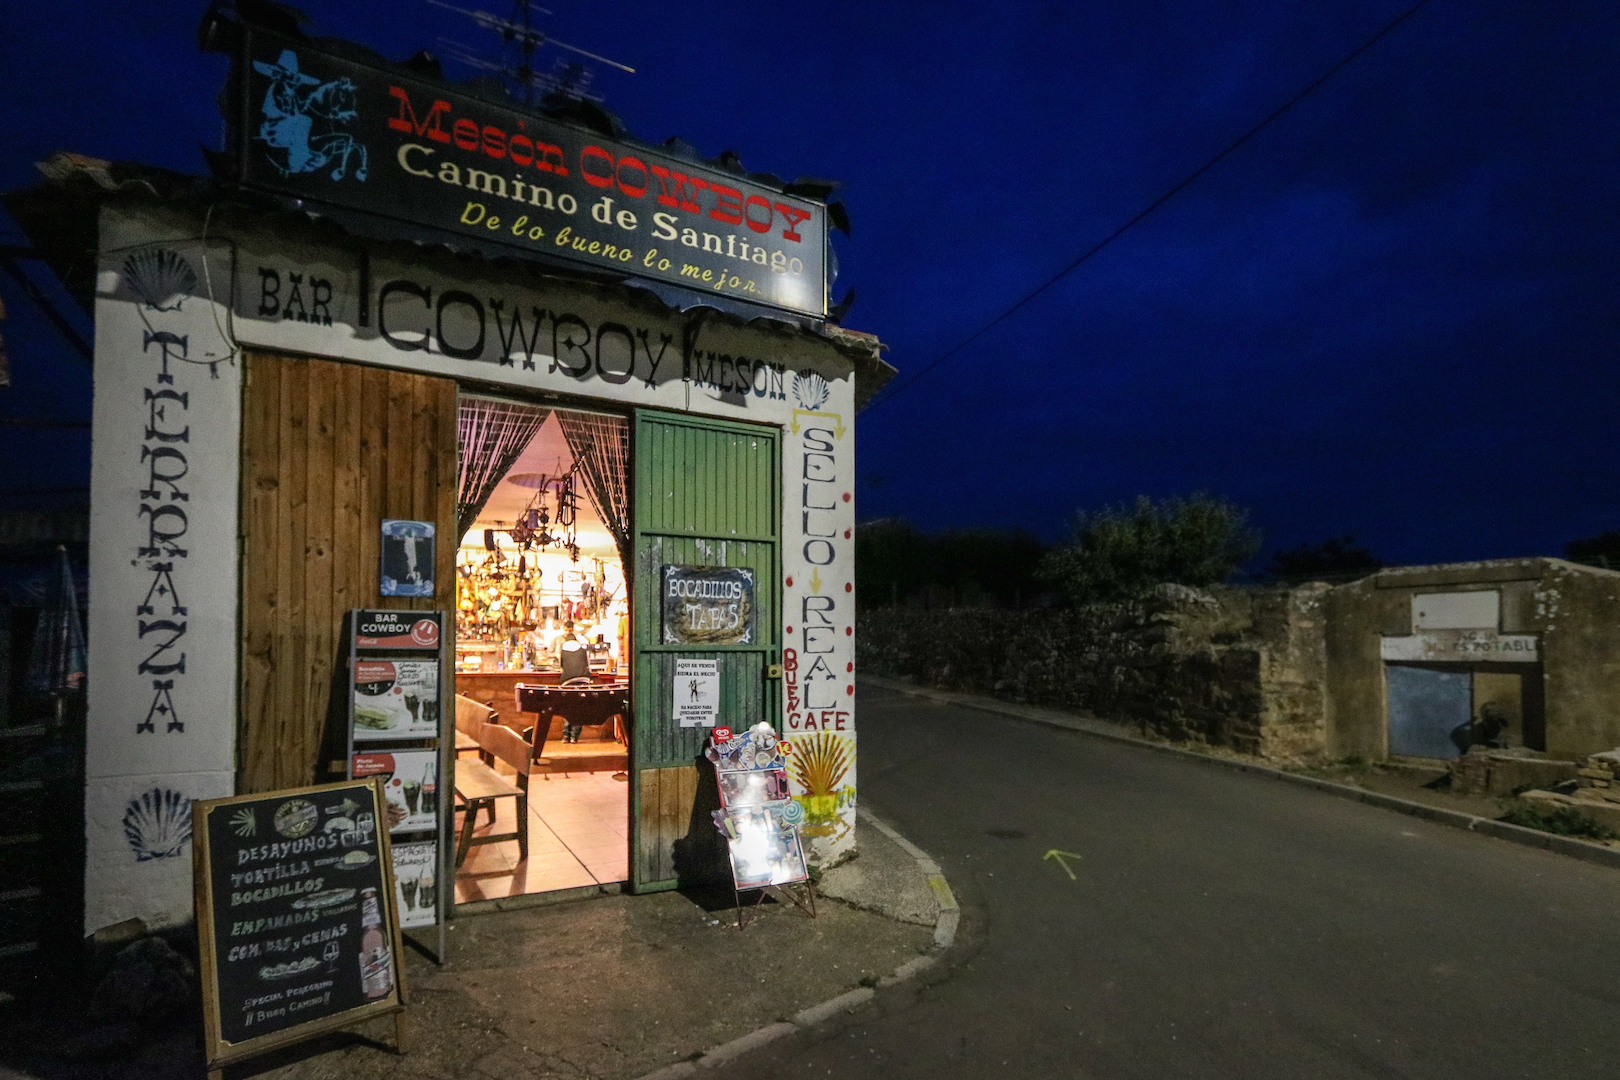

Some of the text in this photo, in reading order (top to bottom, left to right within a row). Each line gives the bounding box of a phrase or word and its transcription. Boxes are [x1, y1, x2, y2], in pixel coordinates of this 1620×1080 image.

[397, 143, 804, 274] Camino de Santiago
[580, 145, 811, 243] COWBOY
[460, 201, 500, 229] De
[511, 215, 545, 240] lo
[555, 226, 633, 261] bueno
[643, 248, 671, 271] lo
[258, 266, 786, 401] BAR COWBOY MESON
[136, 330, 190, 735] TERRAZA
[802, 427, 836, 710] SELLO REAL
[361, 623, 412, 633] COWBOY
[374, 613, 398, 623] BAR
[686, 603, 739, 631] TAPAS
[789, 710, 850, 731] CAFE
[237, 832, 339, 865] DESAYUNOS
[230, 877, 325, 906] BOCADILLOS
[230, 909, 320, 936] EMPANADAS
[302, 923, 348, 946] CENAS
